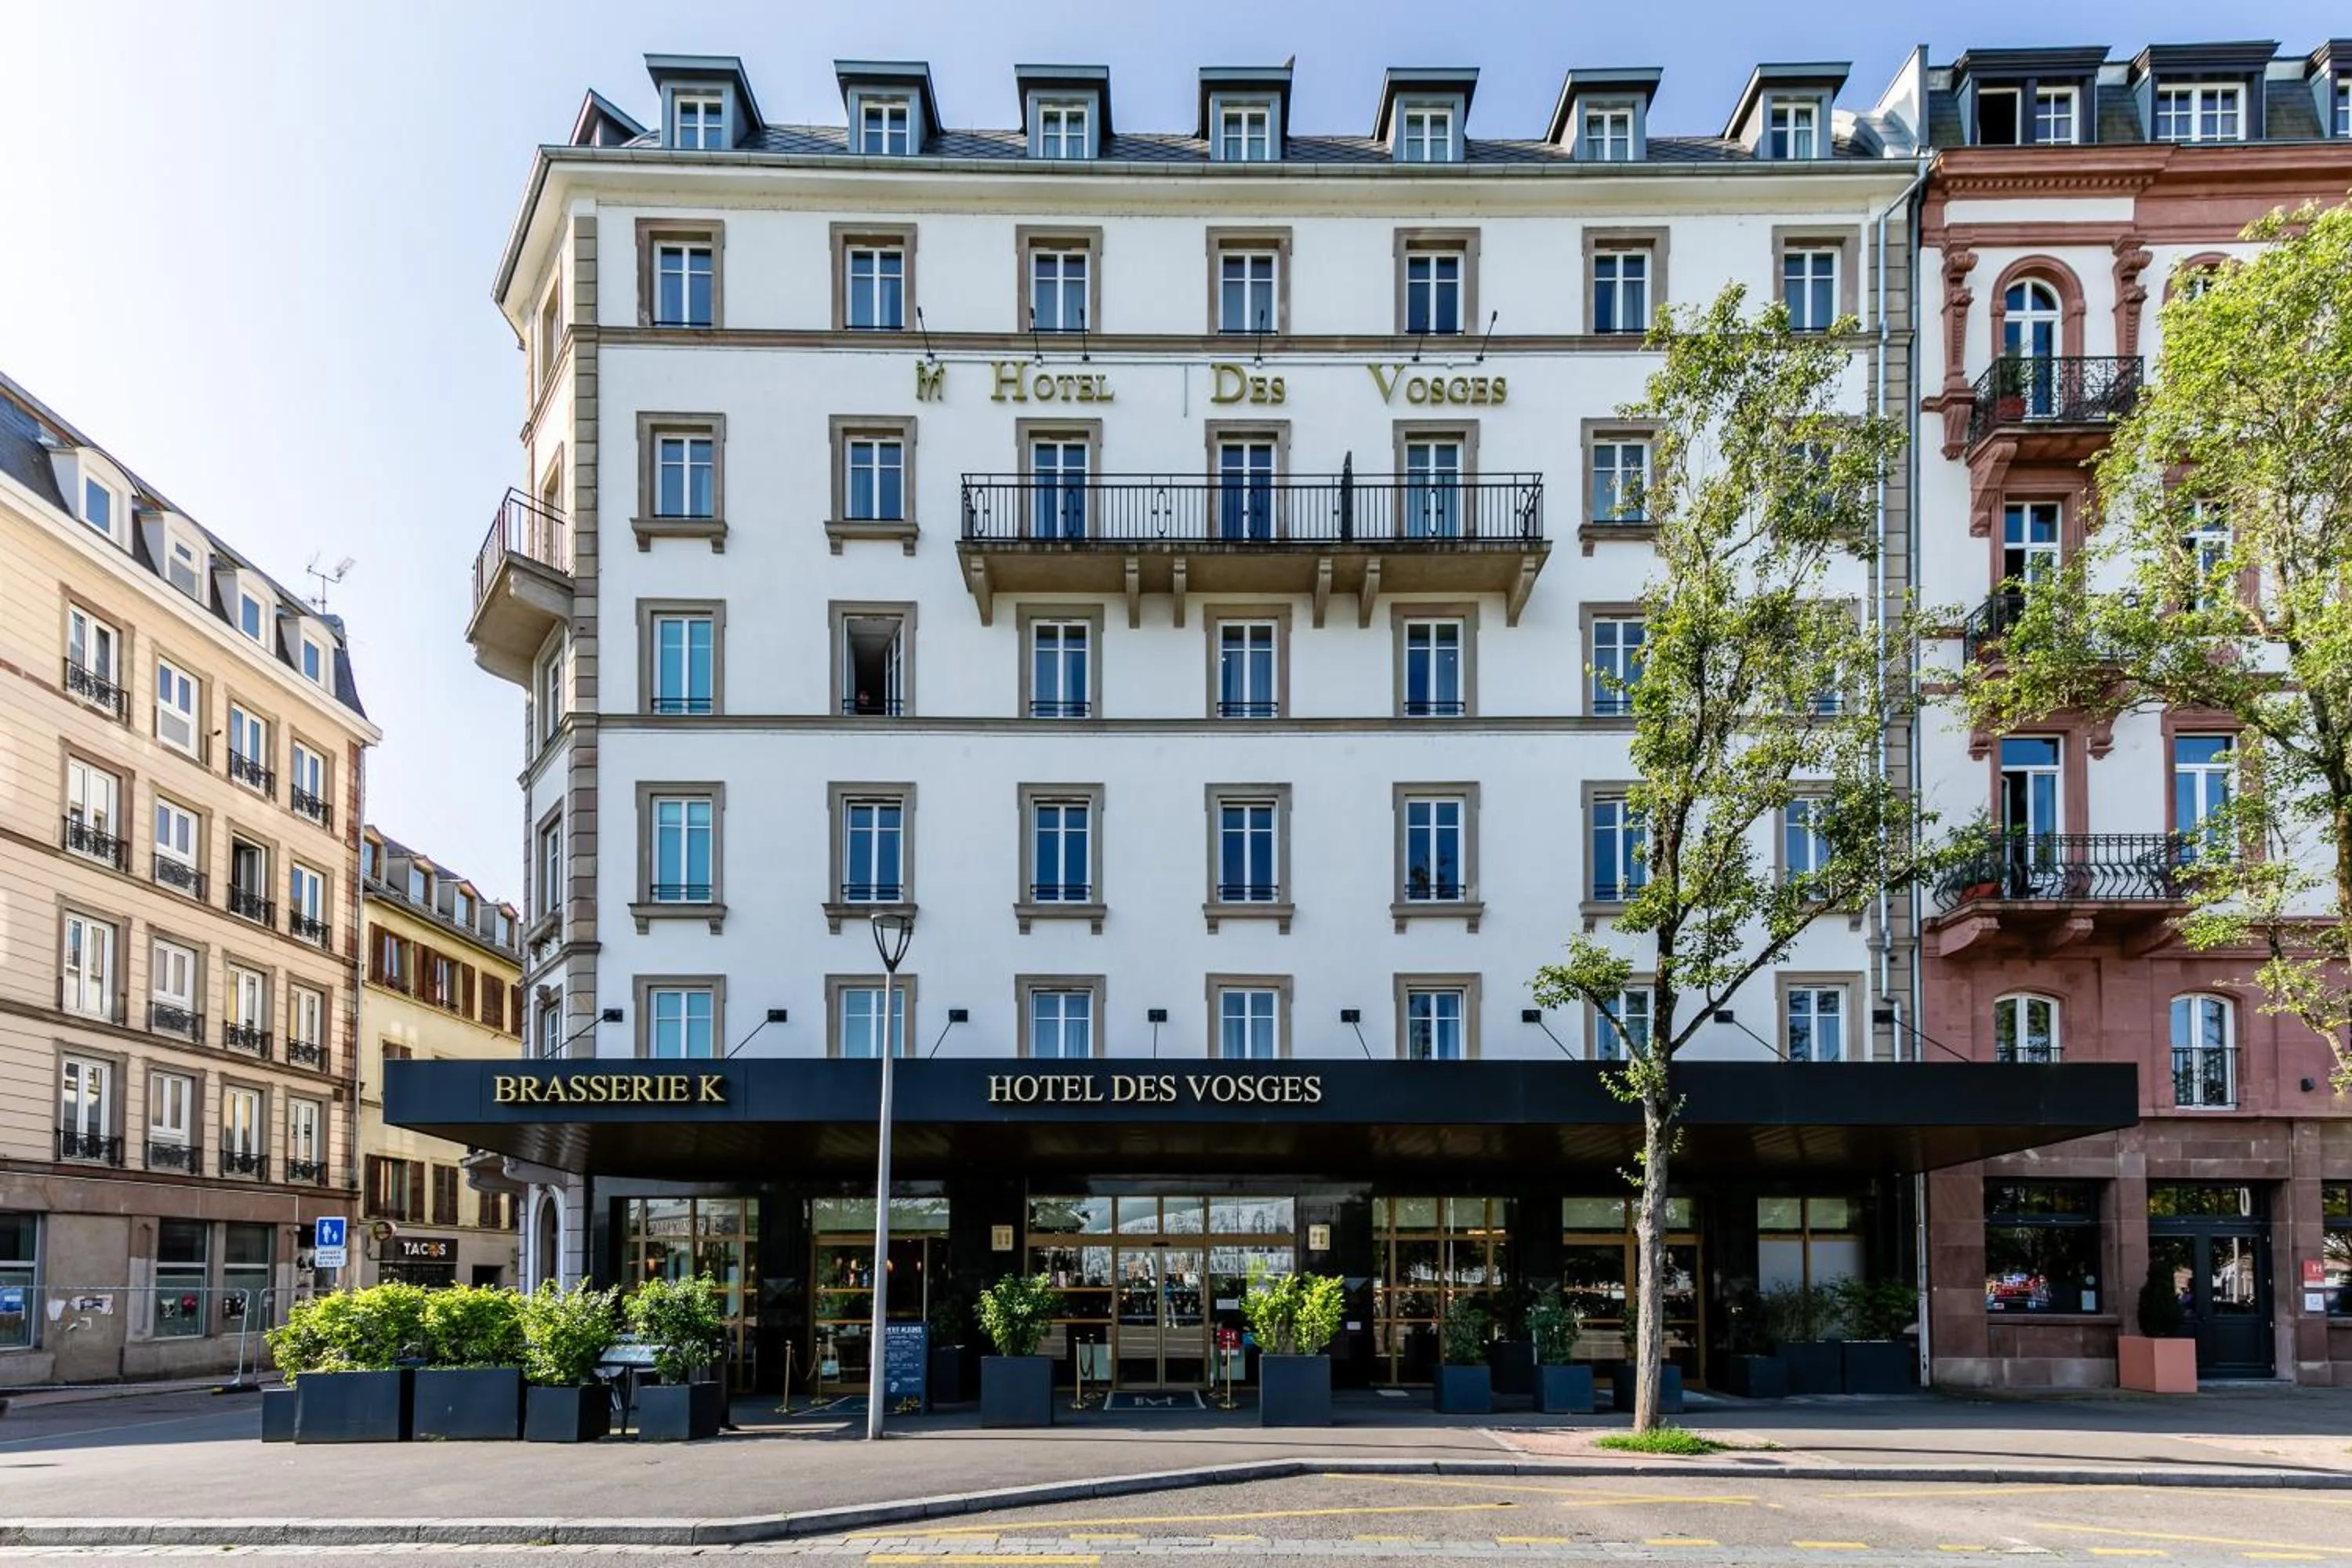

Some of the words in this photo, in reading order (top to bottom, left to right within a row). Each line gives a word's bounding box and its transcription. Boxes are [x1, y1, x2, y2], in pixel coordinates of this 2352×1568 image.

[493, 1075, 690, 1102] BRASSERIE
[697, 1075, 725, 1102] K
[988, 1075, 1104, 1102] HOTEL
[1111, 1075, 1177, 1102] DES
[1186, 1075, 1323, 1103] VOSGES
[403, 1242, 447, 1257] TACOS
